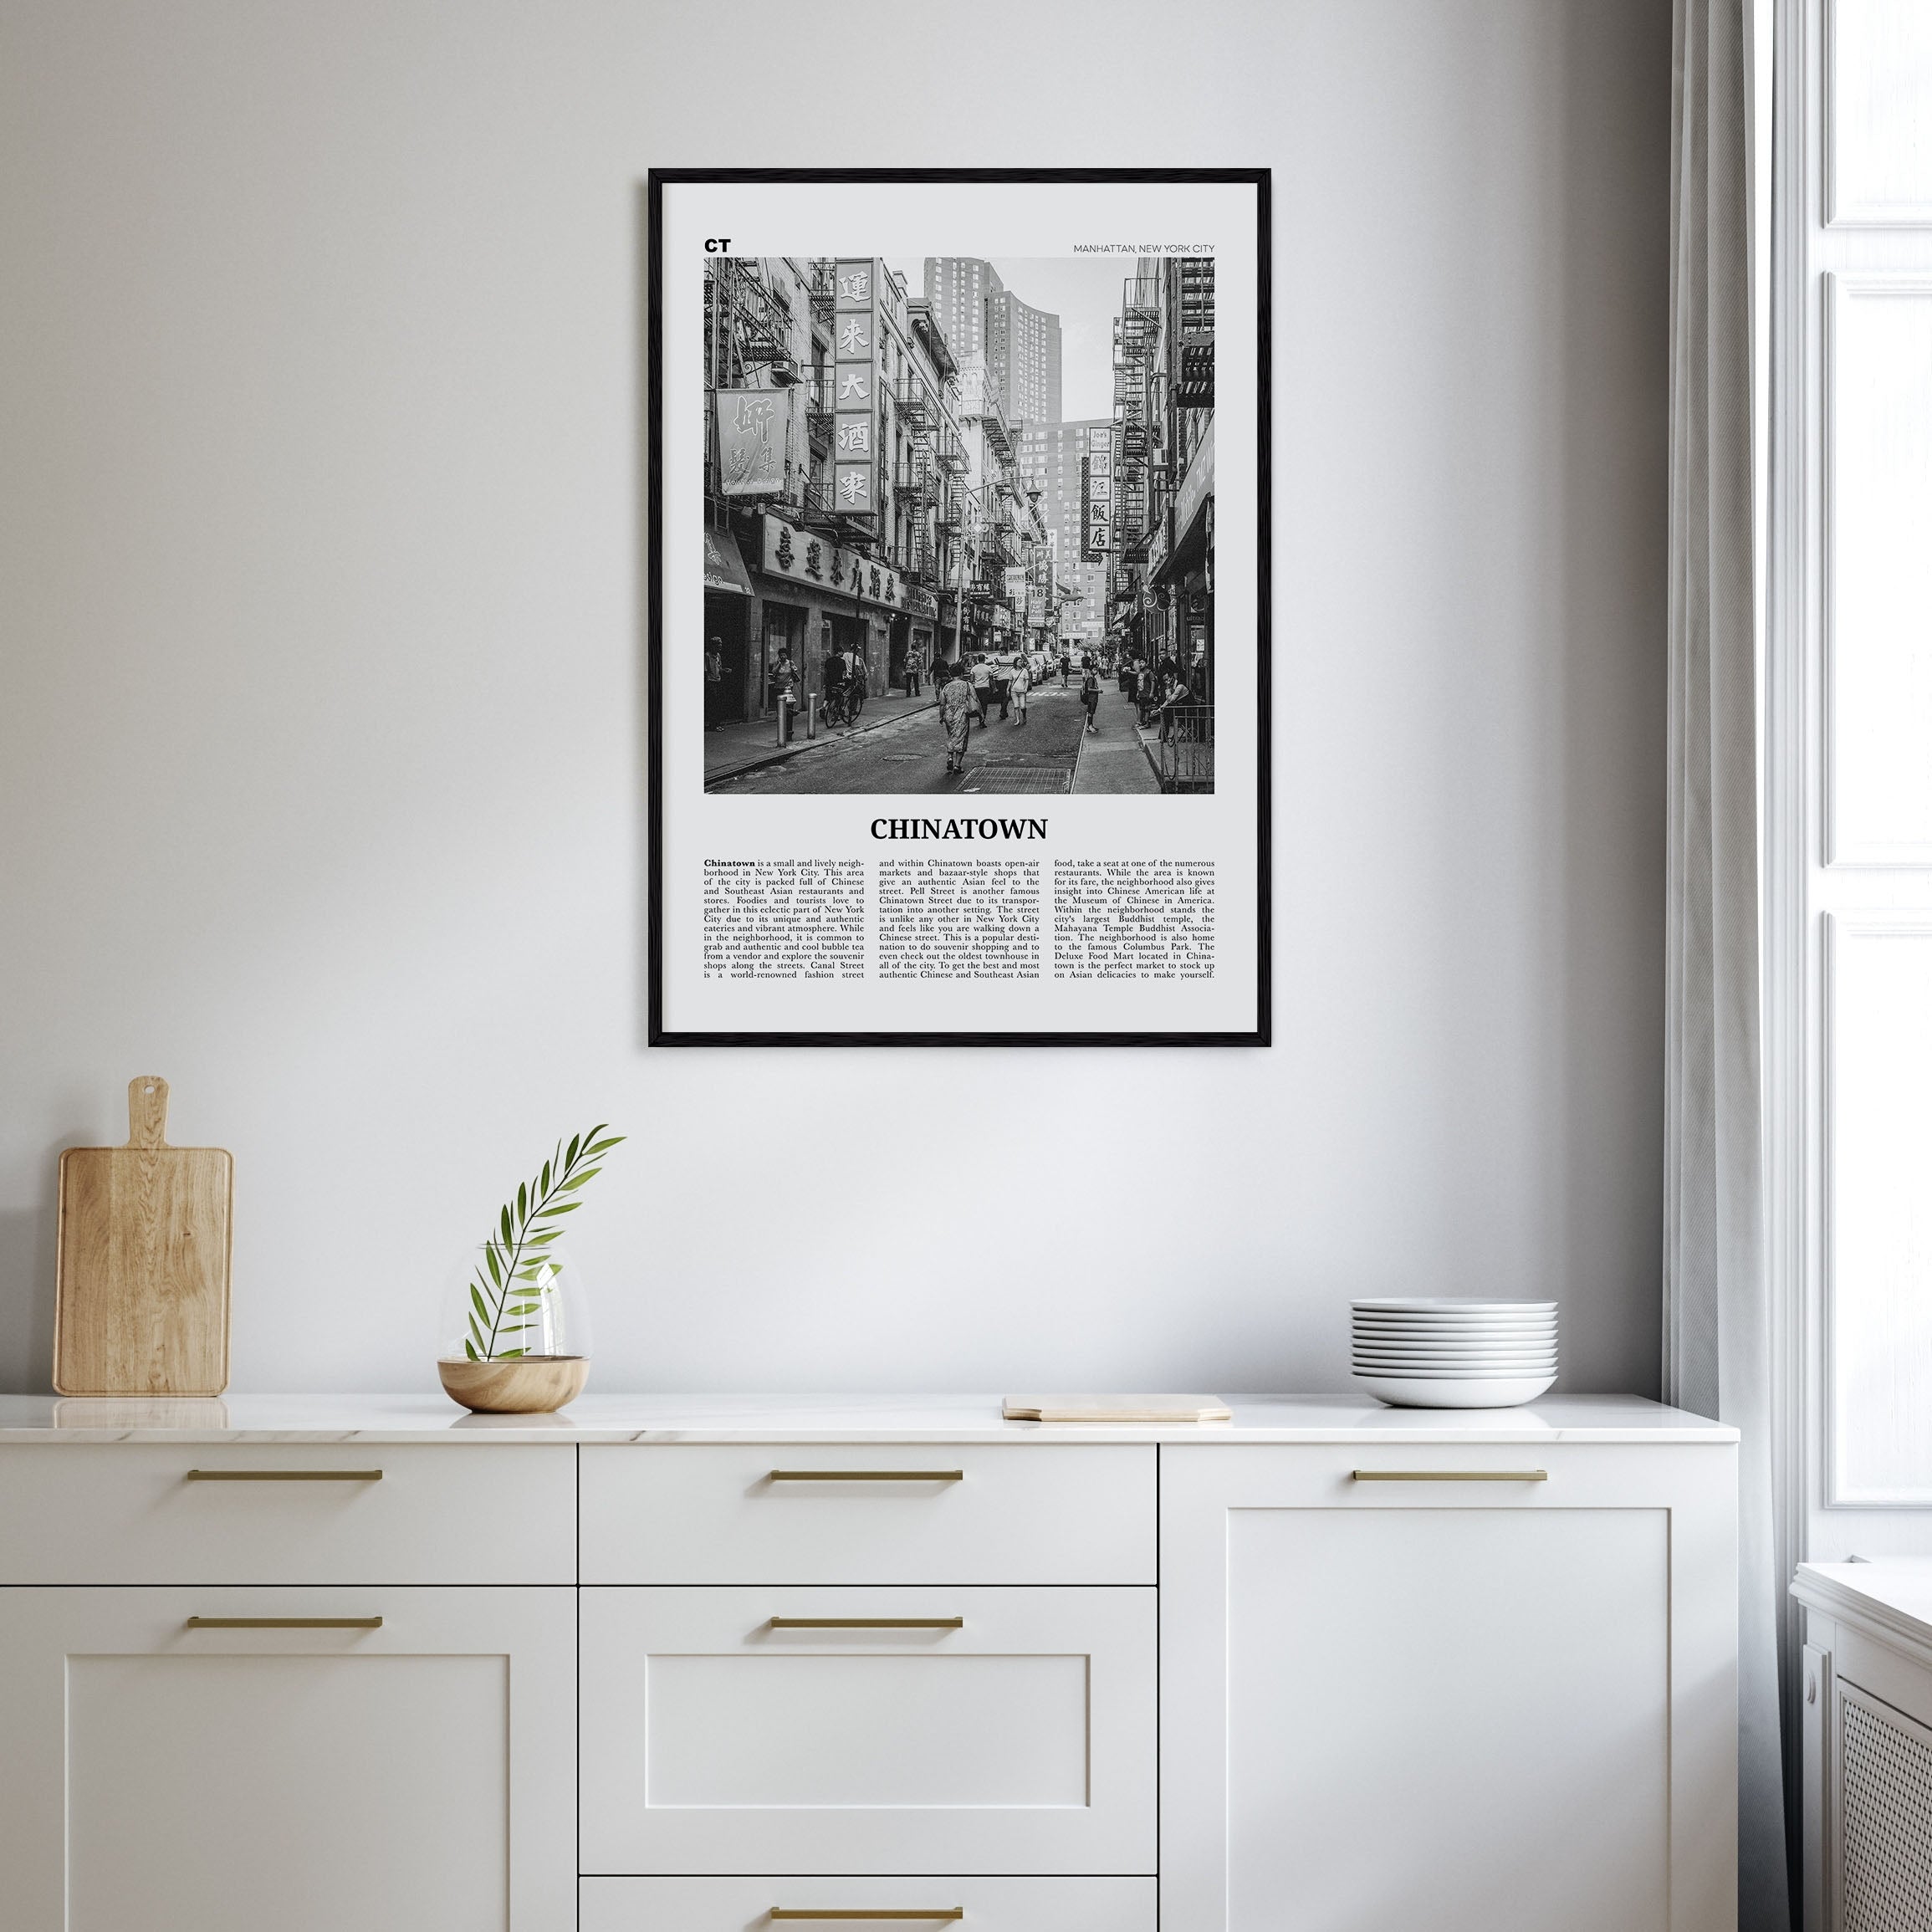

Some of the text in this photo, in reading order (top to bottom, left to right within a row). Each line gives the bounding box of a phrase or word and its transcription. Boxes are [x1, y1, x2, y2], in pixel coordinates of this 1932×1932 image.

[705, 238, 731, 253] CT
[1074, 244, 1214, 254] MANHATTAN, NEW YORK CITY
[837, 271, 871, 504] 運來大酒家
[1091, 440, 1110, 450] Ginger
[1031, 589, 1043, 597] 18
[871, 819, 1048, 839] CHINATOWN
[704, 858, 755, 866] Chinatown
[758, 858, 764, 866] is
[774, 858, 794, 866] small
[797, 858, 812, 866] and
[815, 858, 836, 869] lively
[839, 858, 864, 869] neigh-
[879, 858, 1040, 869] and within Chinatown boasts open-air
[1055, 858, 1075, 867] food,
[1078, 858, 1094, 866] take
[1103, 858, 1118, 866] seat
[1122, 858, 1128, 866] at
[1148, 858, 1158, 866] of
[1160, 858, 1172, 866] the
[704, 867, 738, 876] borhood
[743, 867, 750, 876] in
[755, 867, 774, 876] New
[778, 867, 796, 876] York
[801, 867, 819, 878] City.
[824, 867, 842, 876] This
[1055, 867, 1101, 876] restaurants.
[1107, 867, 1131, 876] While
[1137, 867, 1148, 876] the
[1177, 867, 1183, 876] is
[1188, 867, 1214, 876] known
[879, 877, 895, 887] give
[918, 877, 956, 885] authentic
[963, 877, 984, 885] Asian
[992, 877, 1005, 885] feel
[1012, 877, 1020, 885] to
[1027, 877, 1039, 885] the
[879, 886, 1040, 894] street. Pell Street is another famous
[1055, 886, 1214, 897] insight into Chinese American life at
[704, 896, 864, 904] stores. Foodies and tourists love to
[1055, 896, 1214, 904] the Museum of Chinese in America.
[704, 905, 864, 915] gather in this eclectic part of New York
[880, 914, 1039, 924] is unlike any other in New York City
[1055, 923, 1214, 933] Mahayana Temple Buddhist Associa-
[704, 933, 712, 941] in
[717, 933, 728, 941] the
[733, 933, 792, 943] neighborhood,
[797, 933, 802, 941] it
[807, 933, 813, 941] is
[856, 933, 864, 941] to
[880, 942, 1039, 952] nation to do souvenir shopping and to
[1055, 942, 1214, 950] to the famous Columbus Park. The
[879, 960, 1040, 971] all of the city. To get the best and most
[704, 969, 710, 978] is
[731, 969, 796, 978] world-renowned
[805, 969, 834, 978] fashion
[842, 969, 864, 978] street
[1070, 969, 1092, 978] Asian
[1097, 969, 1136, 978] delicacies
[1142, 969, 1149, 978] to
[1154, 969, 1175, 978] make
[1180, 969, 1214, 980] yourself.
